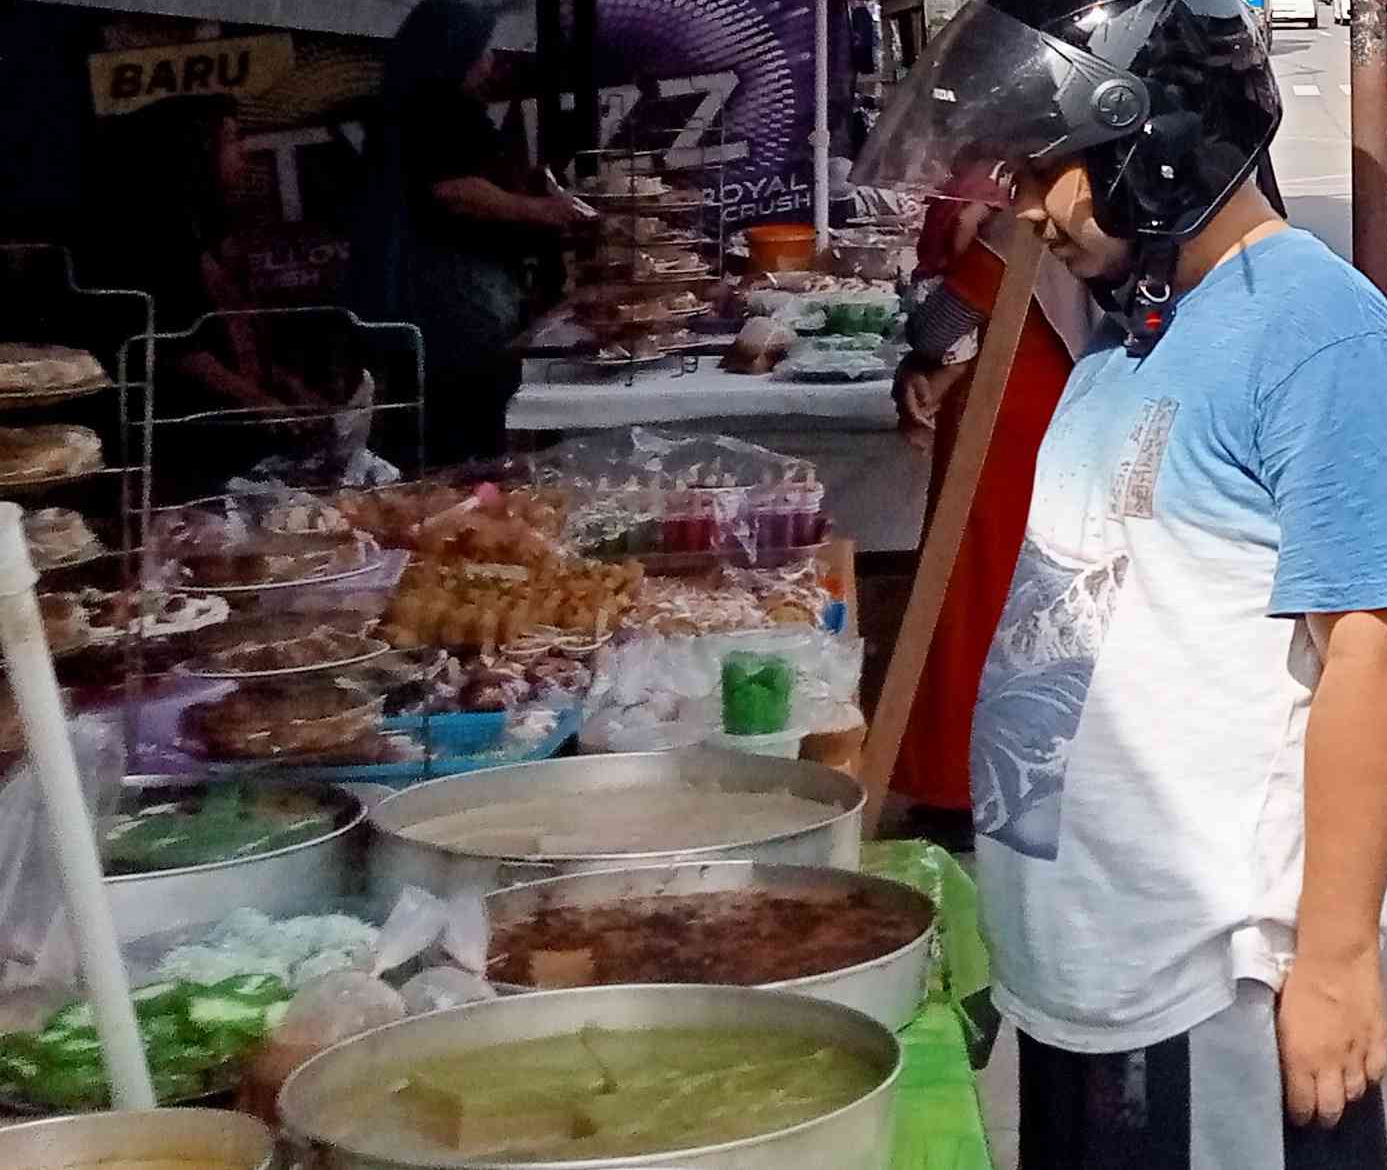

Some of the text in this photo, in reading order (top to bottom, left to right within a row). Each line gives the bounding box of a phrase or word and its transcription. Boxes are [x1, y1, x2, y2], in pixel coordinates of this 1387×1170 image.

[111, 50, 250, 99] BARU
[703, 174, 808, 208] ROYAL
[723, 196, 811, 223] CRUSH
